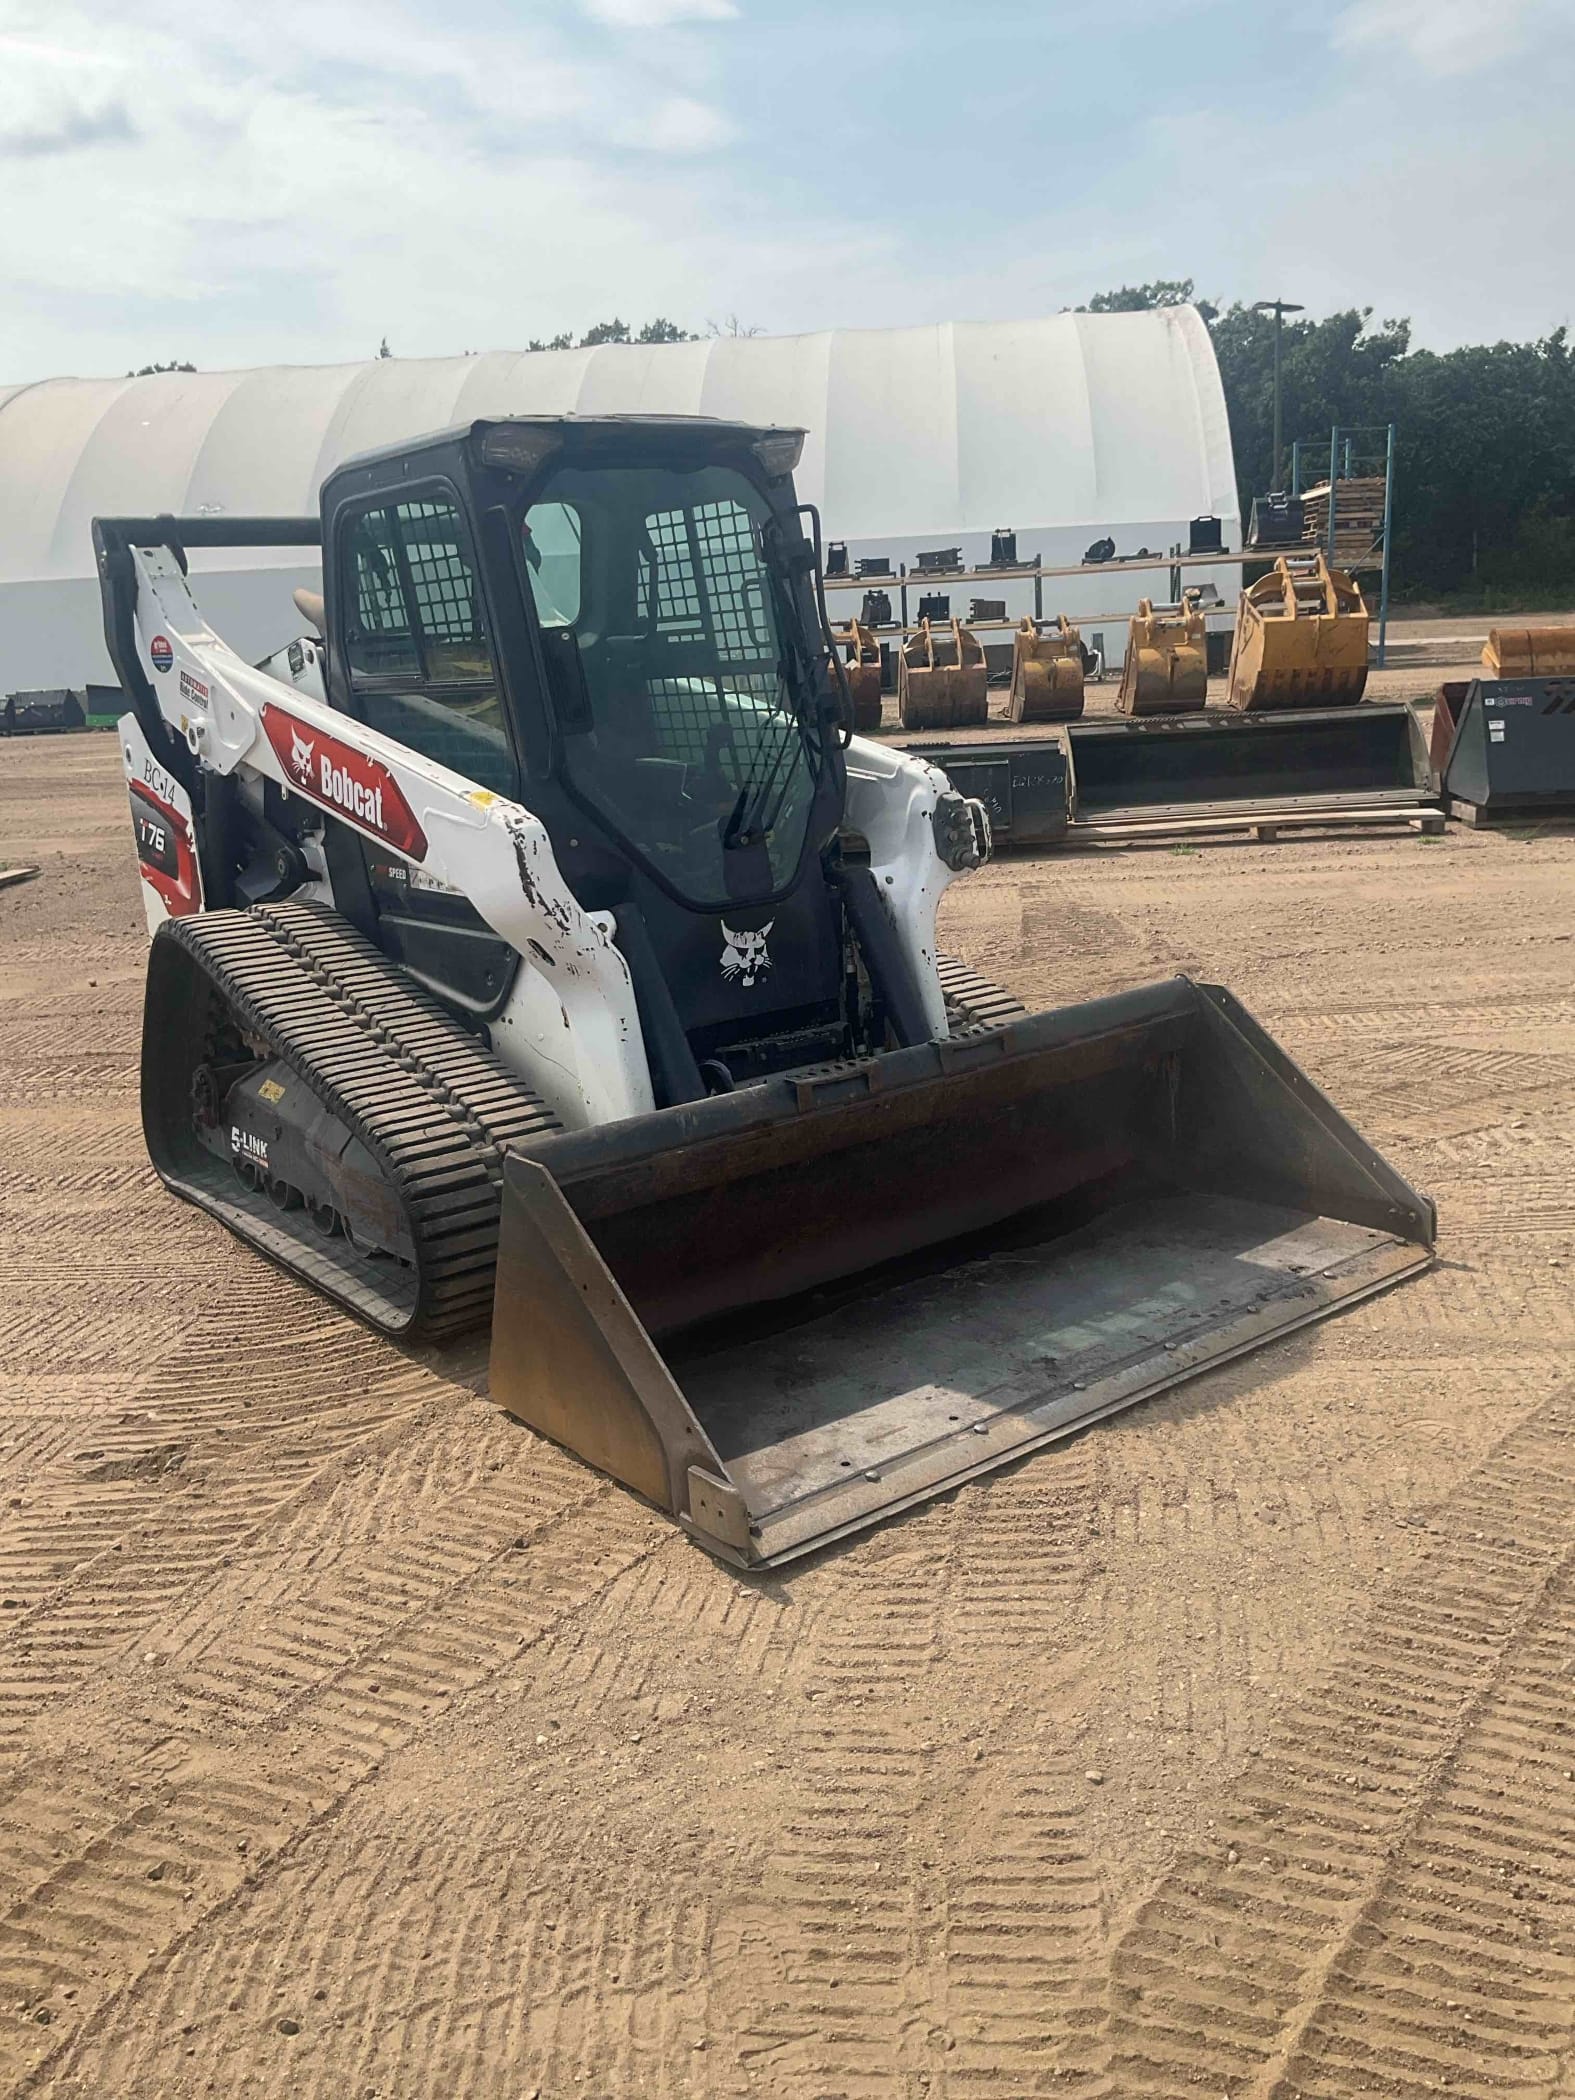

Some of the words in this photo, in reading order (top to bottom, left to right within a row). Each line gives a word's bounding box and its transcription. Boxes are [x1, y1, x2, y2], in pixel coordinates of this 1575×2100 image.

[320, 754, 383, 829] Bobcat
[139, 818, 165, 852] T76
[388, 867, 406, 880] SPEED
[231, 1126, 268, 1159] 5-LINK
